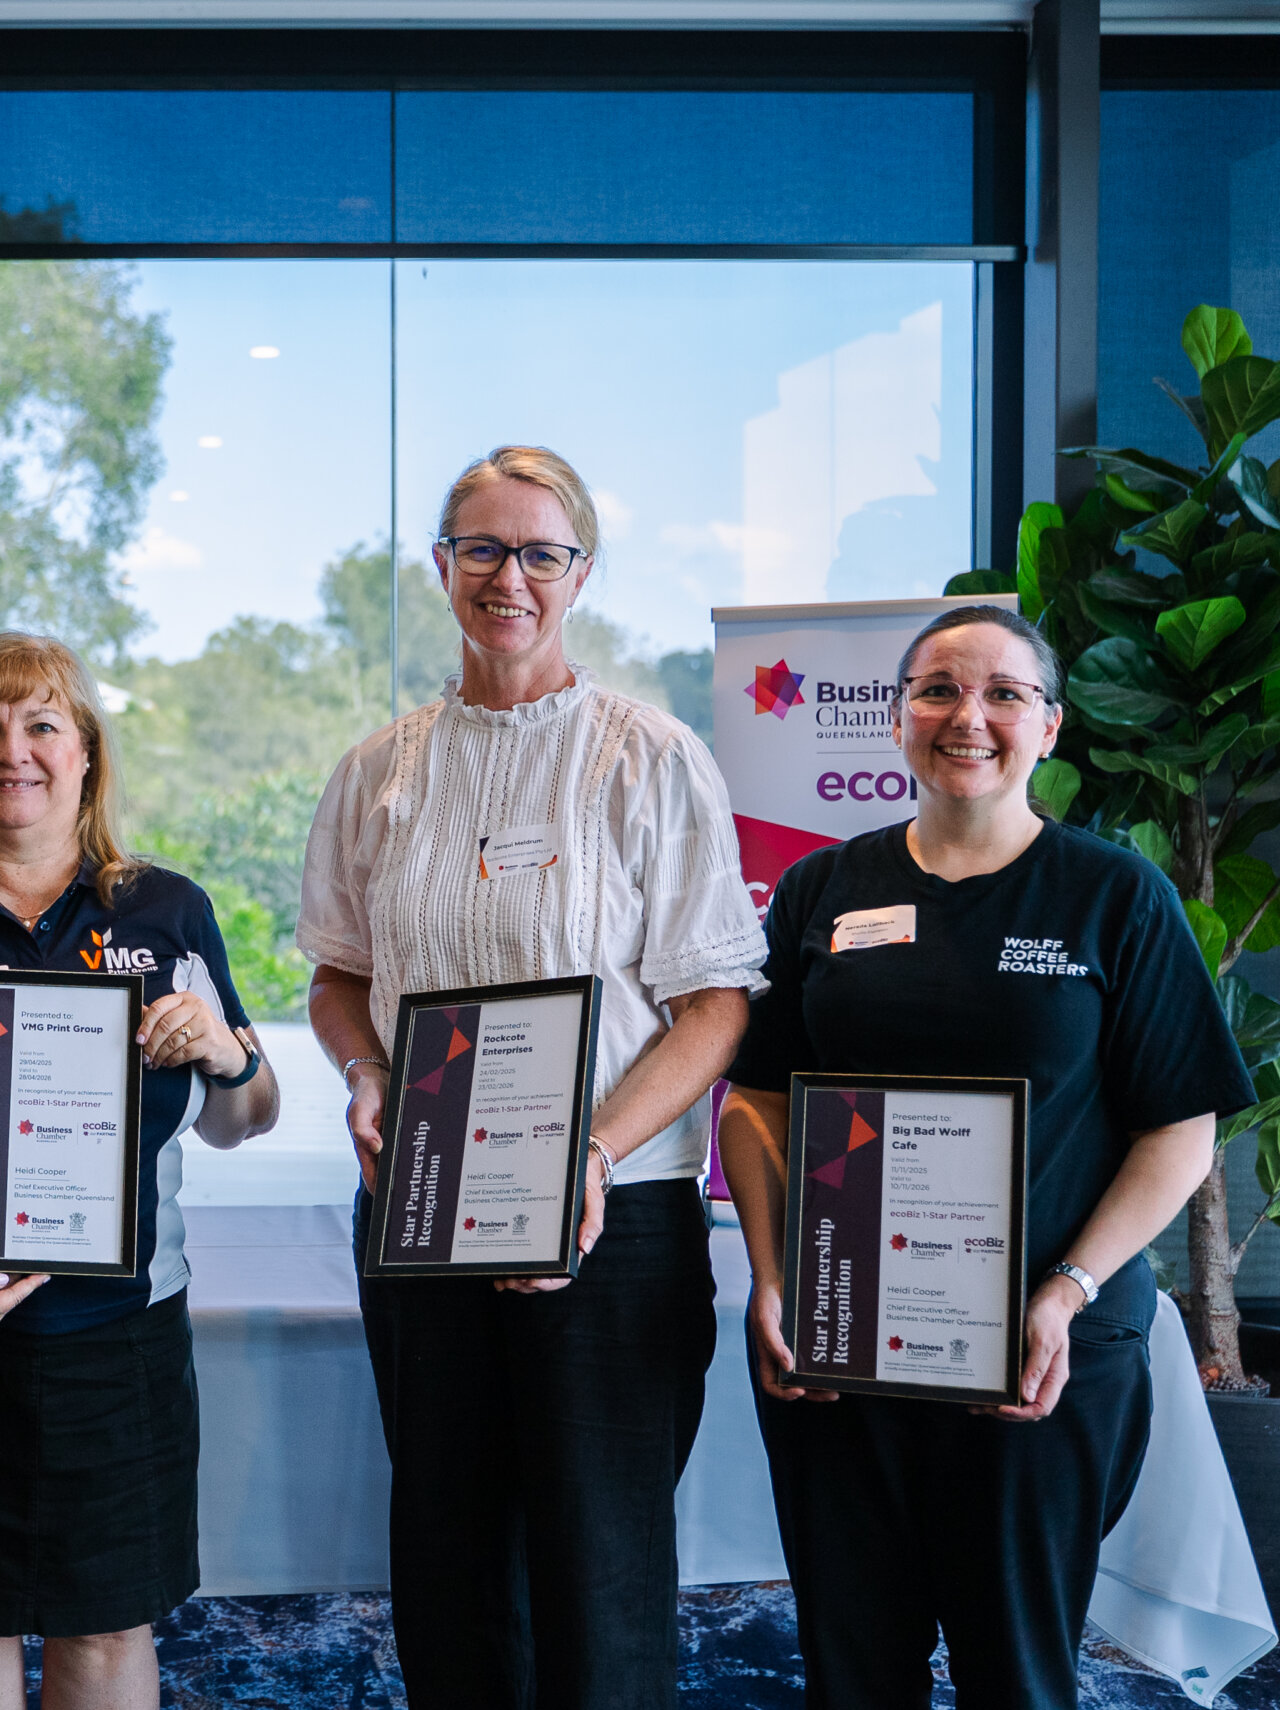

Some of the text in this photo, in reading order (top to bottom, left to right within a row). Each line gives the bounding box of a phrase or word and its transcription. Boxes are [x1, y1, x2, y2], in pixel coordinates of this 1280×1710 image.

[817, 680, 897, 703] Busin
[816, 705, 892, 727] Cham
[817, 731, 892, 739] QUEENSLAND
[1004, 937, 1063, 951] WOLFF
[80, 948, 156, 970] VMG
[1001, 949, 1068, 963] COFFEE
[998, 960, 1088, 976] ROASTERS
[21, 1011, 61, 1019] Presented
[21, 1023, 103, 1034] VMG Print Group
[484, 1022, 521, 1031] Presented
[483, 1033, 526, 1043] Rockcote
[482, 1045, 533, 1056] Enterprises
[18, 1098, 102, 1108] ecoBiz 1-Star Partner
[475, 1106, 500, 1114] ecoBiz
[501, 1105, 521, 1113] 1-Star
[892, 1113, 938, 1122] Presented
[36, 1125, 73, 1134] Business
[82, 1121, 117, 1131] ecoBiz
[533, 1122, 566, 1132] ecoBiz
[490, 1131, 523, 1140] Business
[892, 1126, 971, 1137] Big Bad Wolff
[36, 1133, 66, 1141] Chamber
[489, 1138, 517, 1146] Chamber
[892, 1141, 918, 1150] Cafe
[15, 1167, 67, 1176] Heidi Cooper
[467, 1172, 515, 1181] Heidi Cooper
[400, 1121, 431, 1247] Star Partnership
[75, 1194, 115, 1202] Queensland
[417, 1154, 441, 1247] Recognition
[464, 1195, 558, 1205] Business Chamber Queensland
[890, 1210, 985, 1221] ecoBiz 1-Star Partner
[32, 1217, 65, 1225] Business
[911, 1241, 953, 1250] Business
[964, 1237, 1005, 1248] ecoBiz
[910, 1249, 946, 1258] Chamber
[812, 1218, 835, 1363] Star Partnership
[887, 1286, 946, 1297] Heidi Cooper
[832, 1259, 853, 1365] Recognition
[907, 1305, 943, 1314] Executive
[944, 1308, 970, 1316] Officer
[886, 1314, 1002, 1328] Business Chamber Queensland
[906, 1342, 944, 1352] Business
[906, 1350, 938, 1359] Chamber
